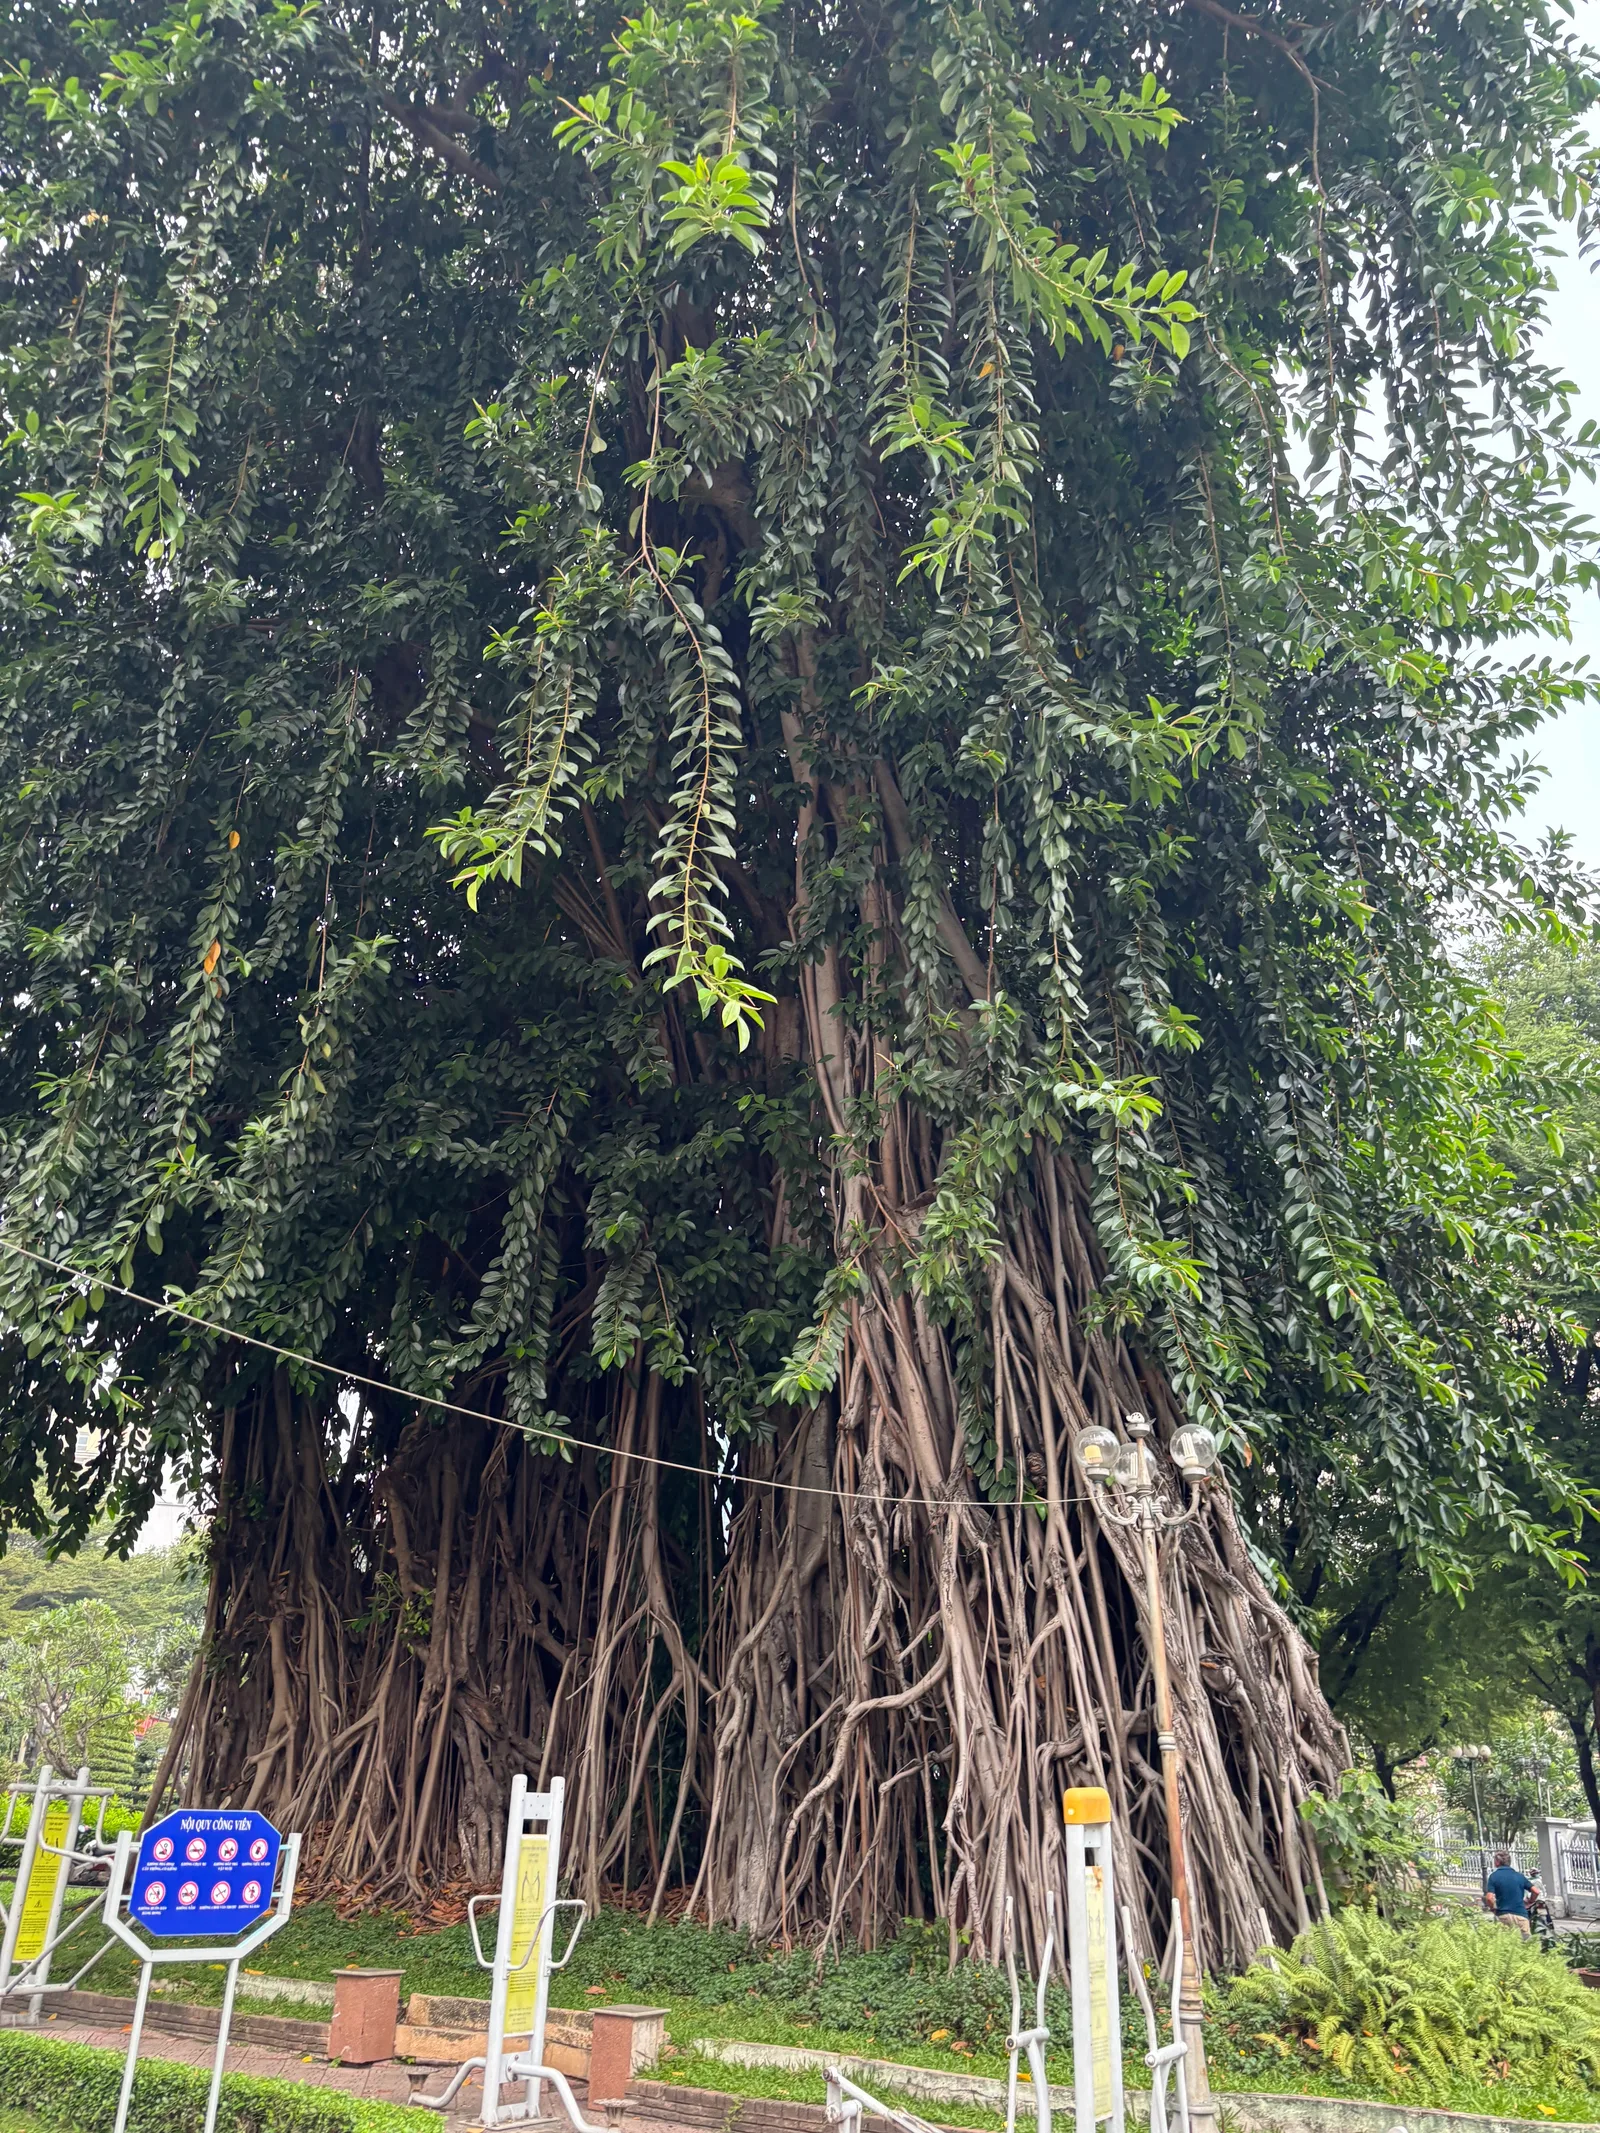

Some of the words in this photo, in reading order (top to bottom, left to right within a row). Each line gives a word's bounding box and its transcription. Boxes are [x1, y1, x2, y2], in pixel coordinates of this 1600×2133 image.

[180, 1816, 195, 1833] NỘI
[195, 1819, 212, 1833] QUY
[212, 1817, 233, 1831] CÔNG
[234, 1817, 252, 1831] VIÊN
